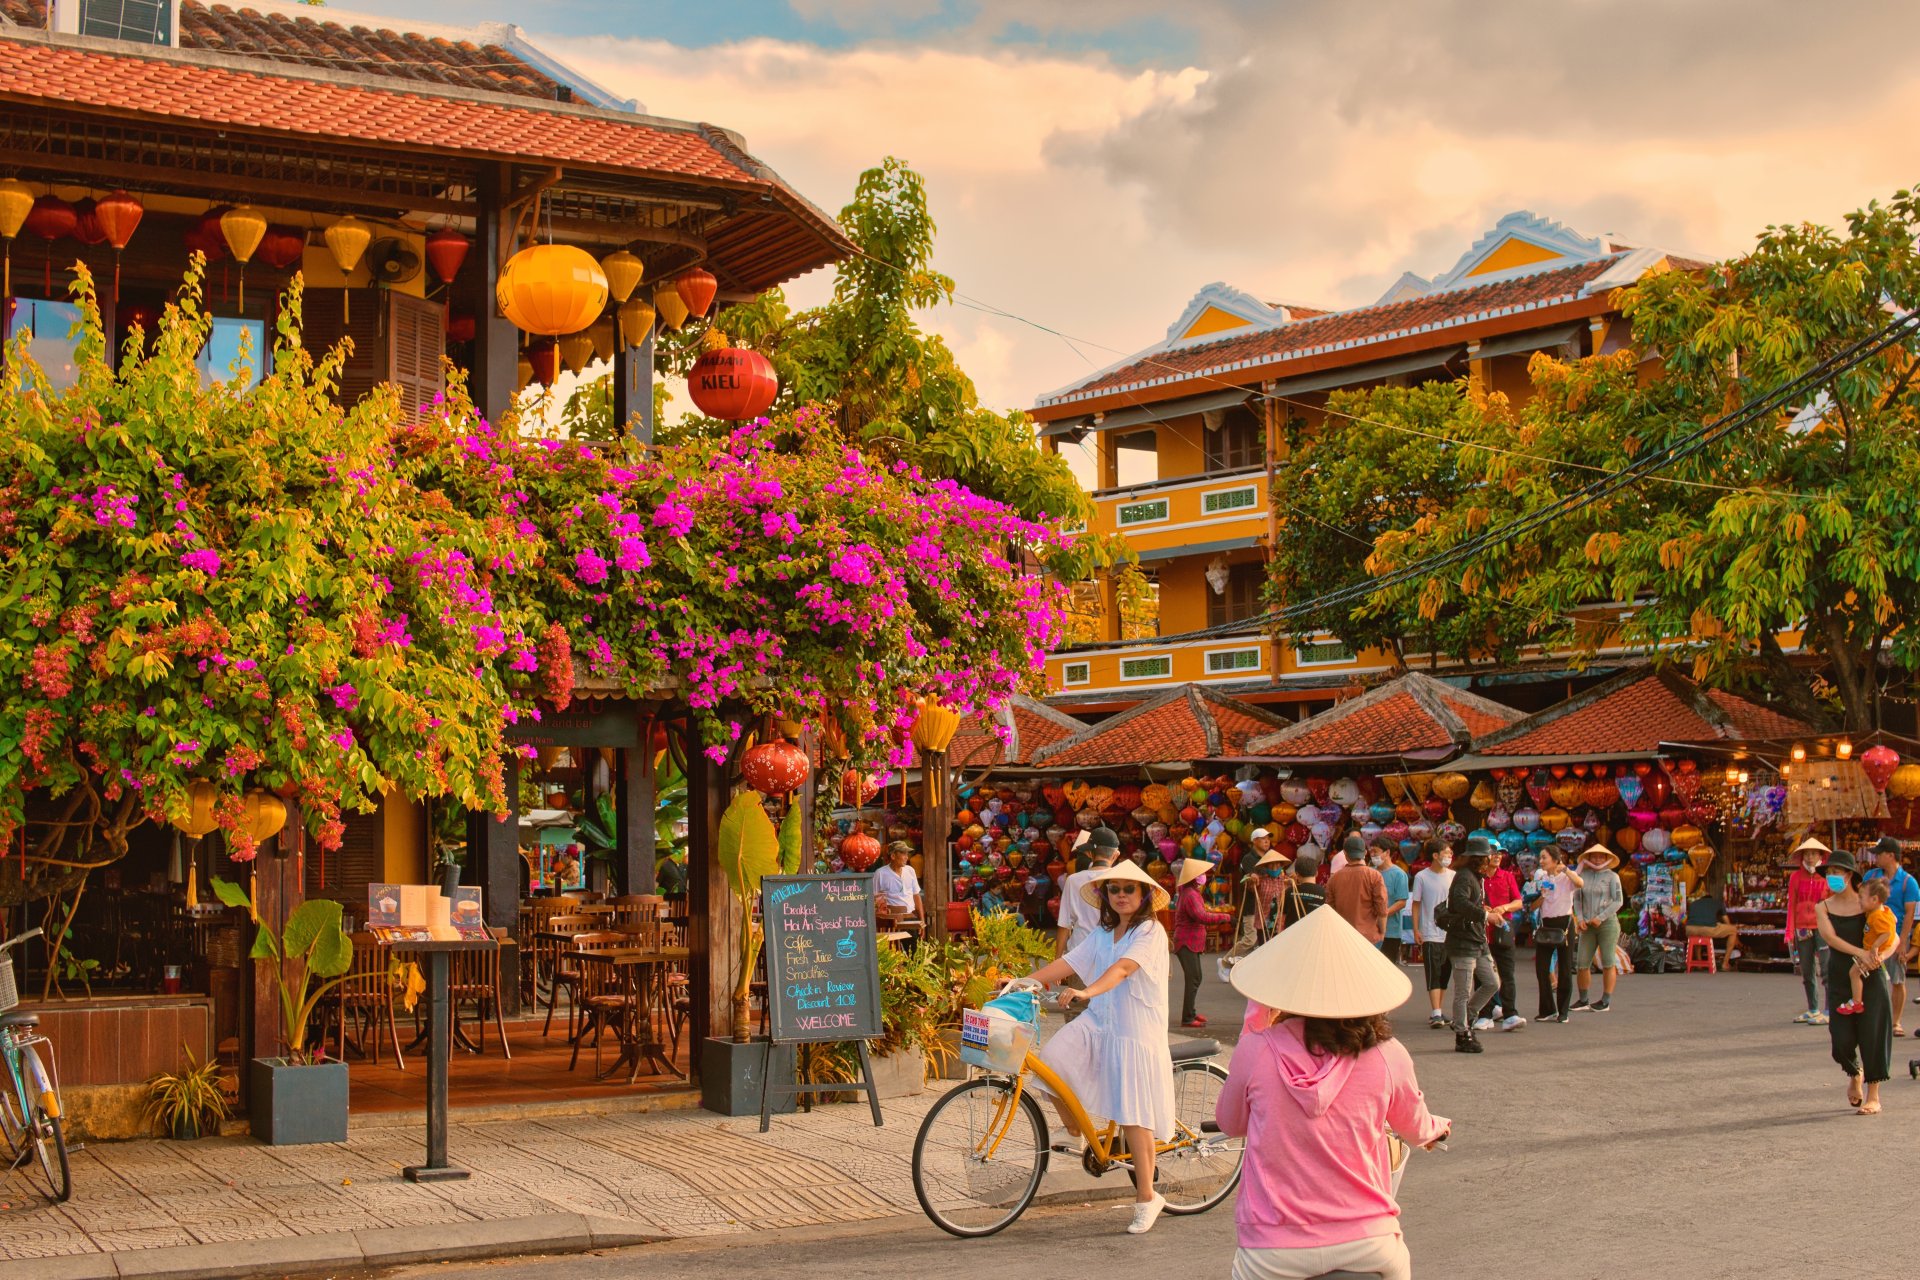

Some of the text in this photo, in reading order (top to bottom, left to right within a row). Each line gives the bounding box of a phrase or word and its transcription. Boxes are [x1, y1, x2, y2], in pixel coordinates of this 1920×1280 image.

[701, 374, 740, 390] KIEU
[551, 719, 572, 728] and
[783, 902, 818, 918] Breakfast
[802, 918, 814, 931] An
[845, 916, 867, 928] Foods
[784, 934, 814, 954] Coffee
[785, 949, 833, 965] Fresh Juice
[786, 965, 829, 981] Smoothies
[827, 980, 854, 993] Review
[797, 995, 831, 1010] Discount
[795, 1013, 857, 1030] WELCOME
